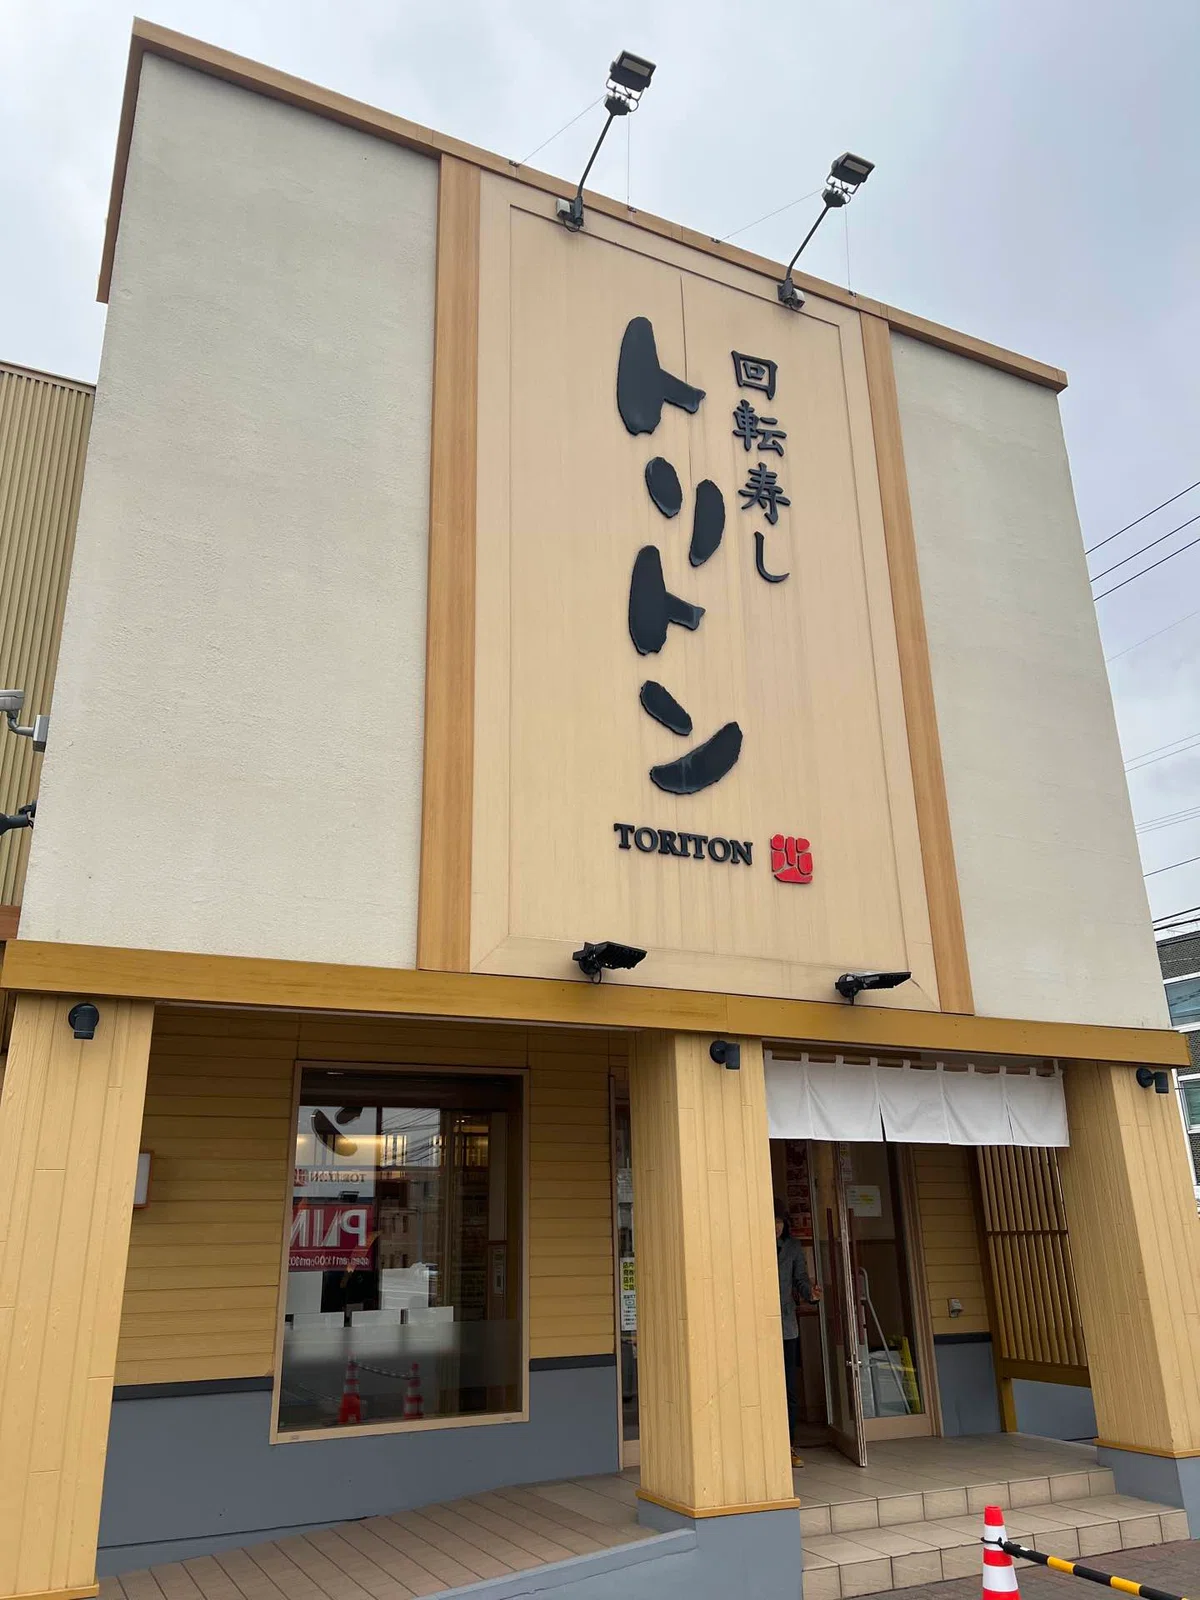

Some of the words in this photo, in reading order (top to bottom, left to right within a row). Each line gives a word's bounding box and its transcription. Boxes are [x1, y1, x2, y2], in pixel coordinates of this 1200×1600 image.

[616, 315, 744, 795] トリトン
[731, 349, 791, 584] 回転寿し
[613, 822, 753, 866] TORITON
